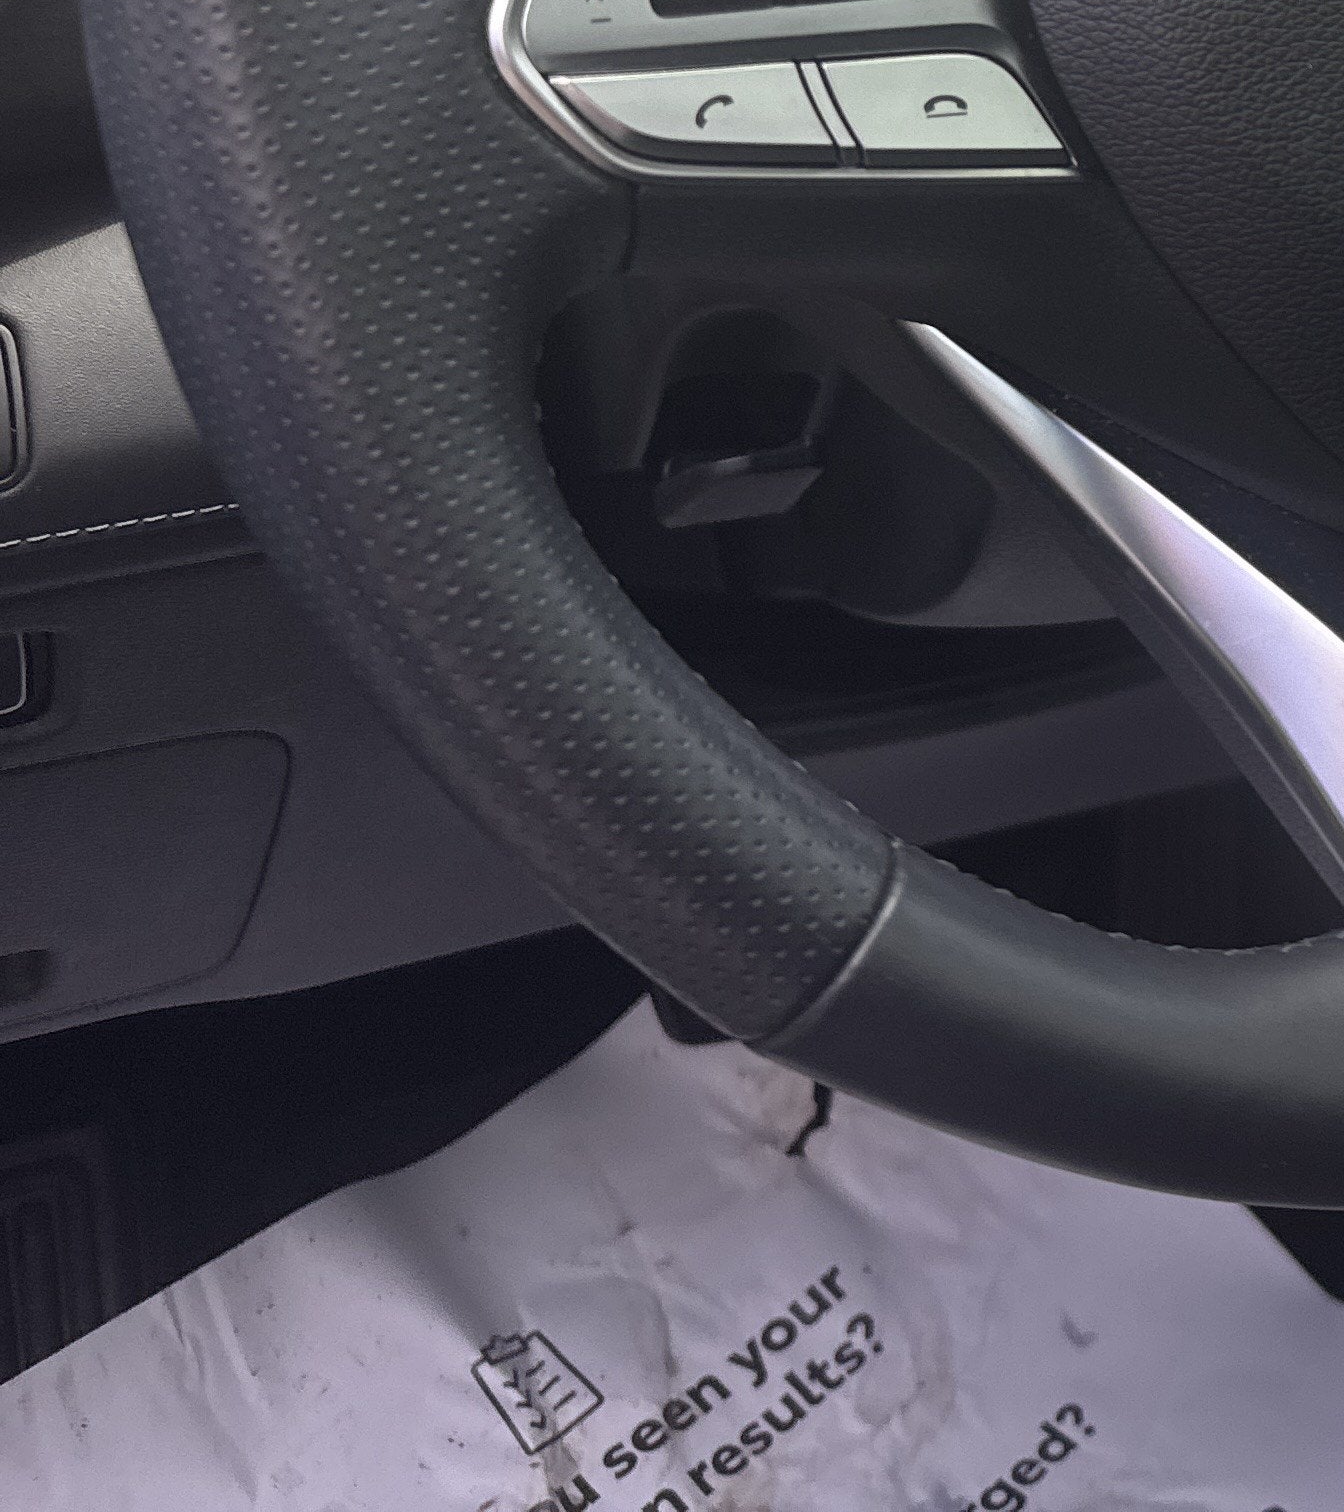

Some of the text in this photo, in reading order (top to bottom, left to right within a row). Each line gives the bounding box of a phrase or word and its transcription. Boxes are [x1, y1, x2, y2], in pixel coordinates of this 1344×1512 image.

[603, 1265, 847, 1479] seen your
[686, 1311, 885, 1497] results?
